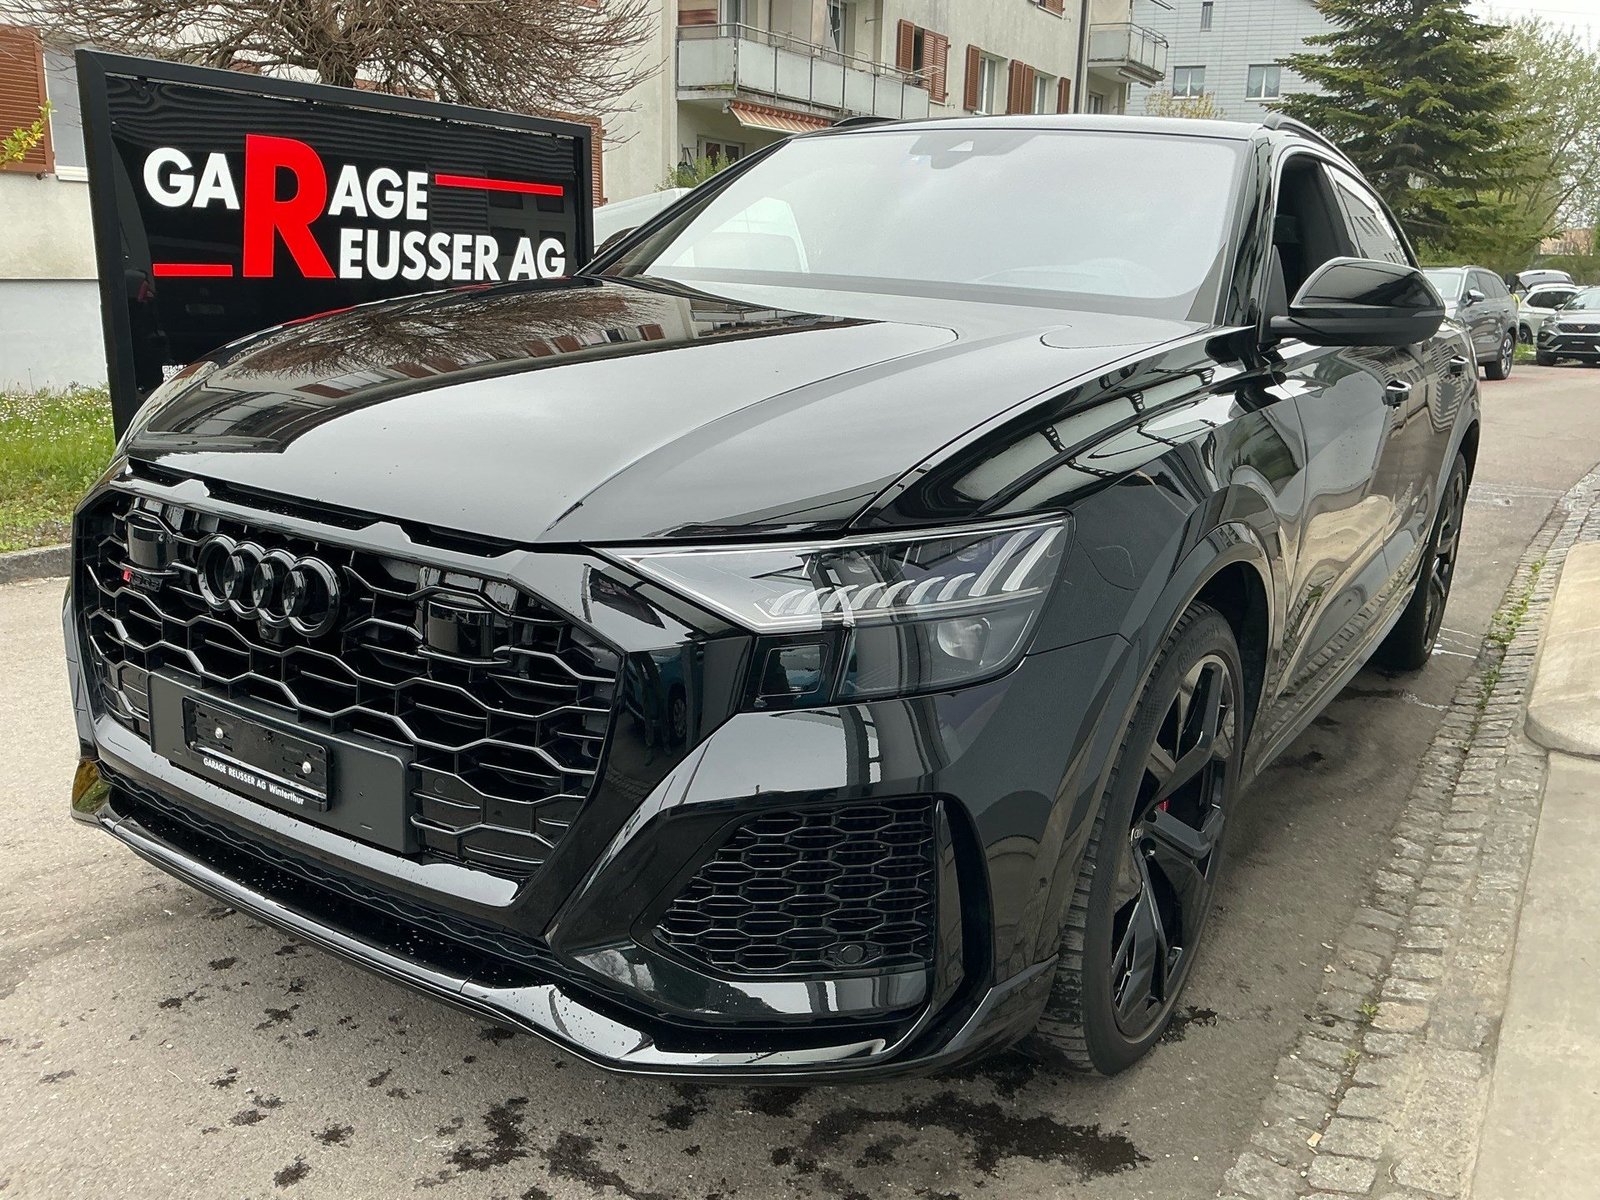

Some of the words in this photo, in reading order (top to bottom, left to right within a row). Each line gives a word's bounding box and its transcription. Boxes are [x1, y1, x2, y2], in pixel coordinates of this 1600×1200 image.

[143, 134, 429, 279] GARAGE
[507, 236, 566, 282] AG
[203, 757, 227, 774] GARAGE
[228, 767, 255, 786] REUSSER
[256, 779, 267, 790] AG
[268, 783, 305, 805] Winterthur
